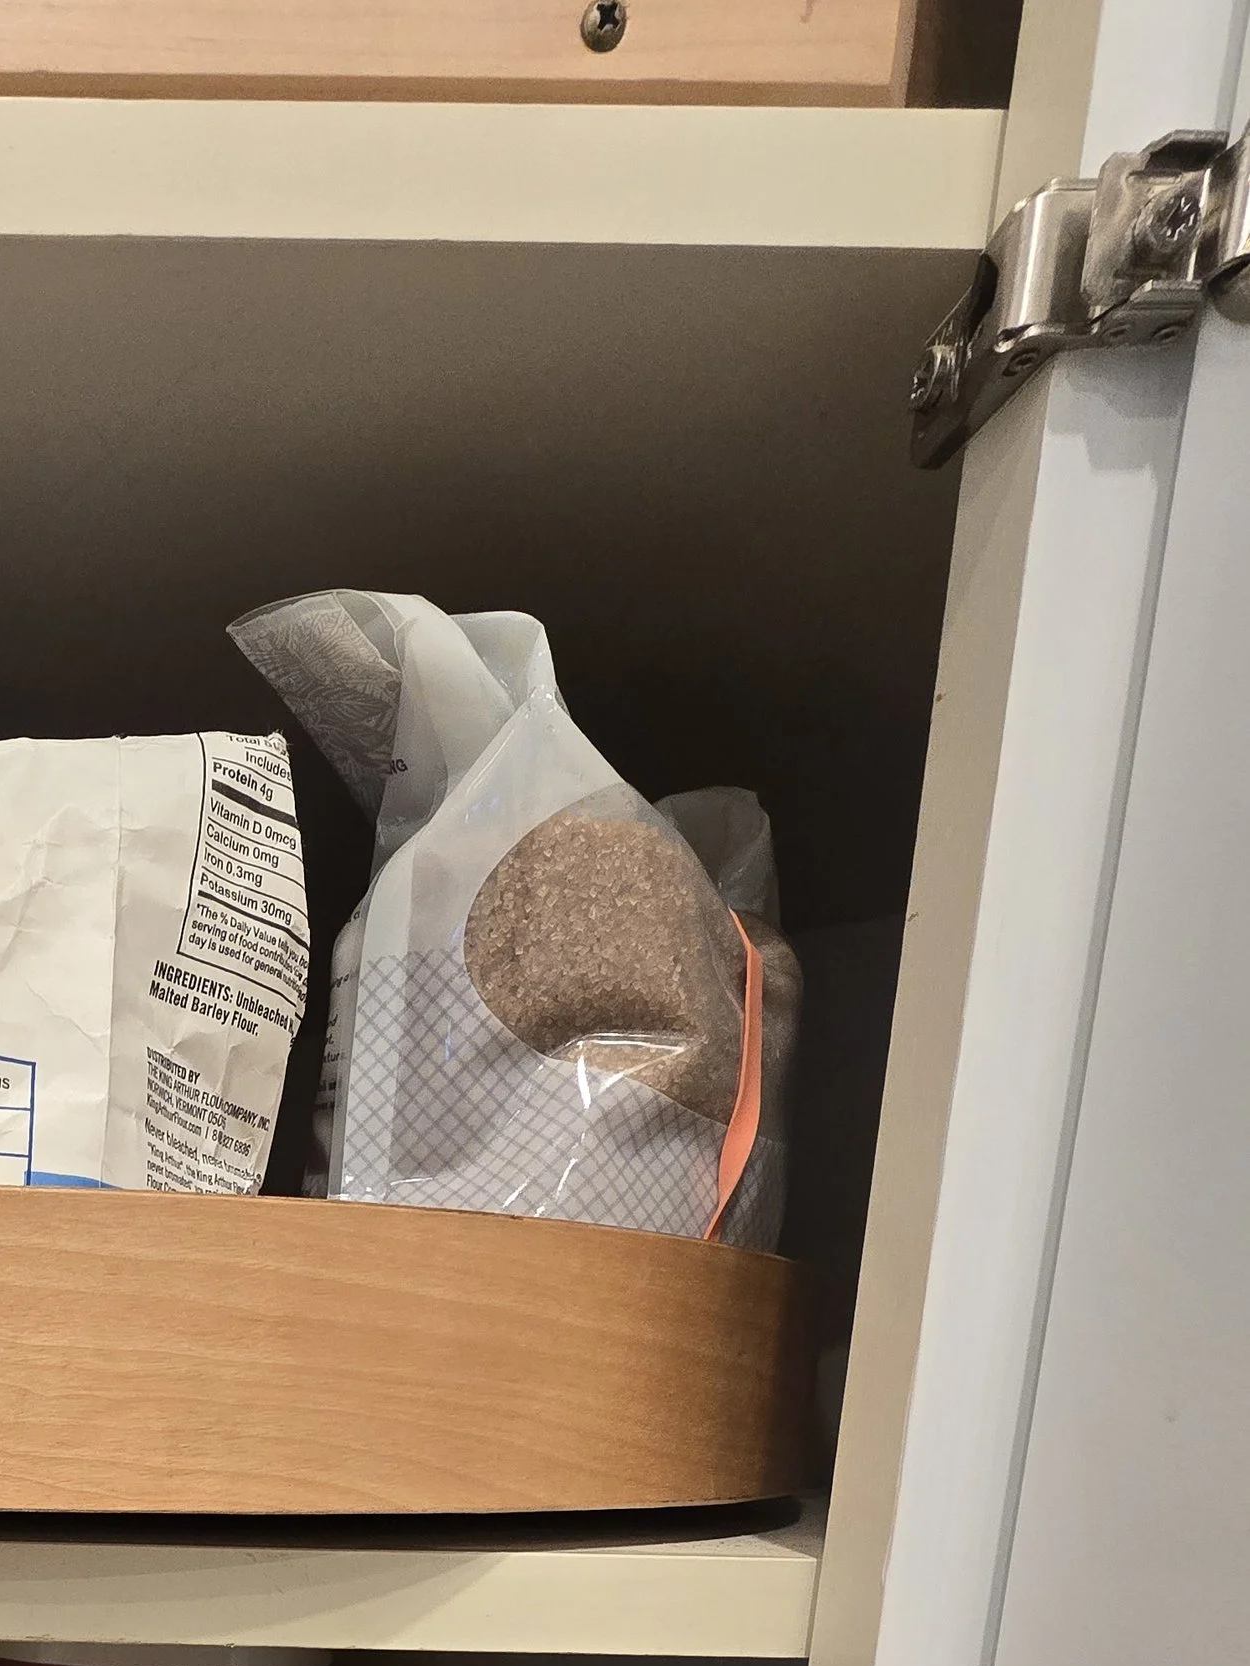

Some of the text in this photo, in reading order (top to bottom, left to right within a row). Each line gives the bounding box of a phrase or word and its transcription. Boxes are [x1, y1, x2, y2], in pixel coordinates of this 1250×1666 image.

[212, 761, 273, 801] Protein 4g
[206, 823, 279, 868] Calcium 0mg
[210, 797, 296, 850] Vitamin D 0mcg
[204, 847, 263, 887] Iron 0.3mg
[200, 873, 292, 925] Potassium 30mg
[150, 980, 260, 1036] Malted Barley Flour.
[154, 960, 289, 1029] INGREDIENTS: Unbleached
[188, 1070, 200, 1085] BY
